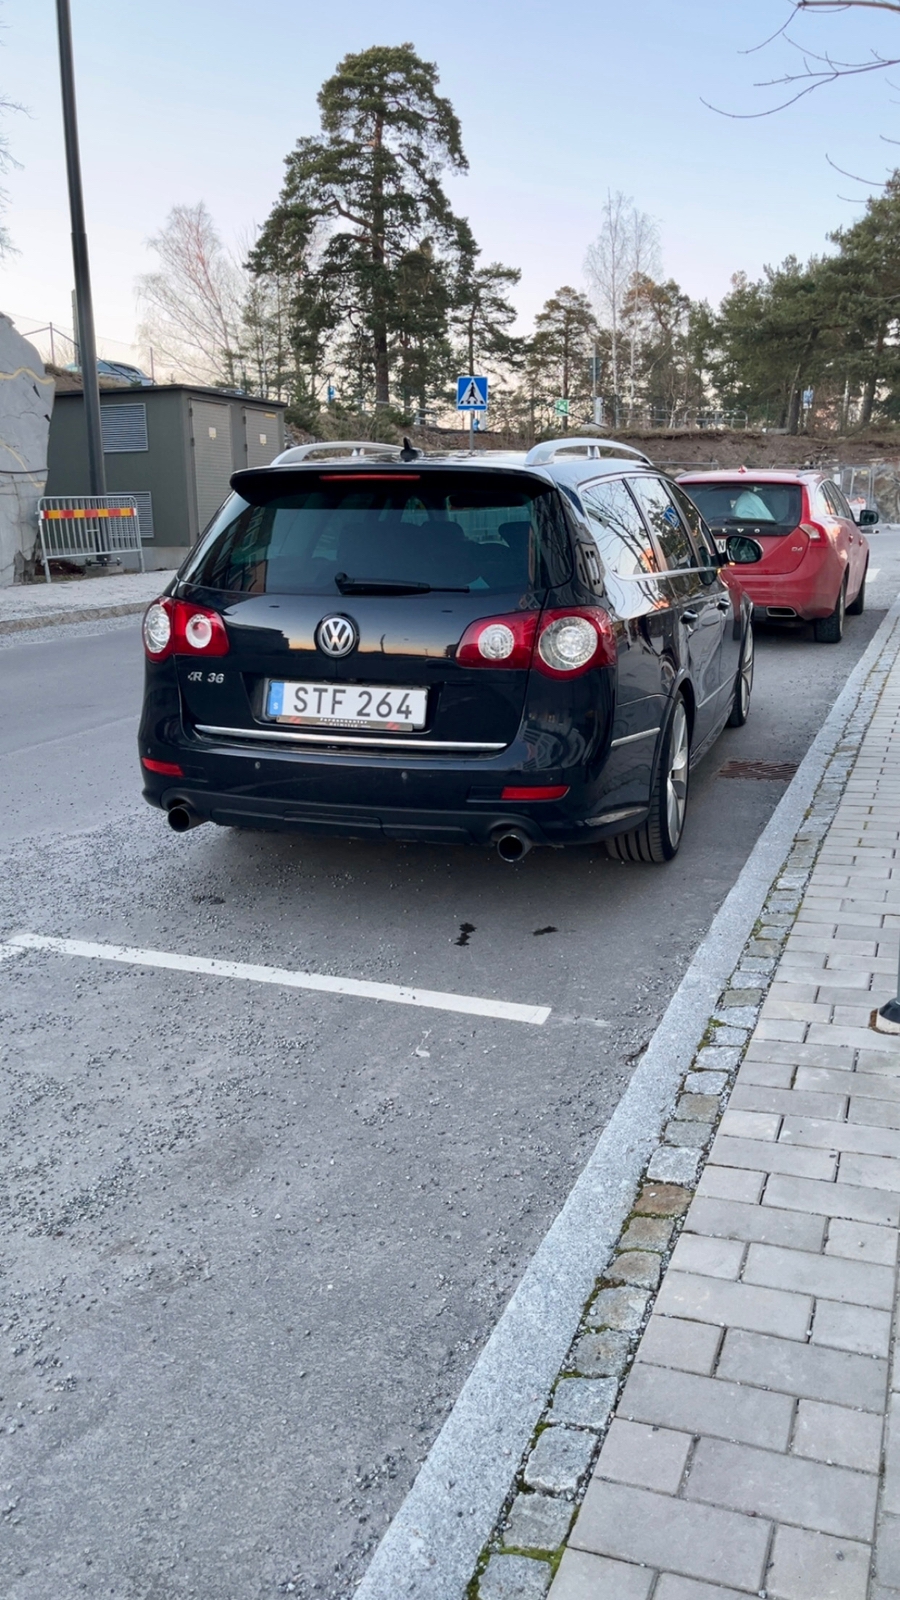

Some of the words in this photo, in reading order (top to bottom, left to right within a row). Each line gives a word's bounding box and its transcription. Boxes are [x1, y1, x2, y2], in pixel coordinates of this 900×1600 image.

[205, 672, 225, 684] 36
[293, 686, 347, 715] STF
[356, 690, 412, 720] 264
